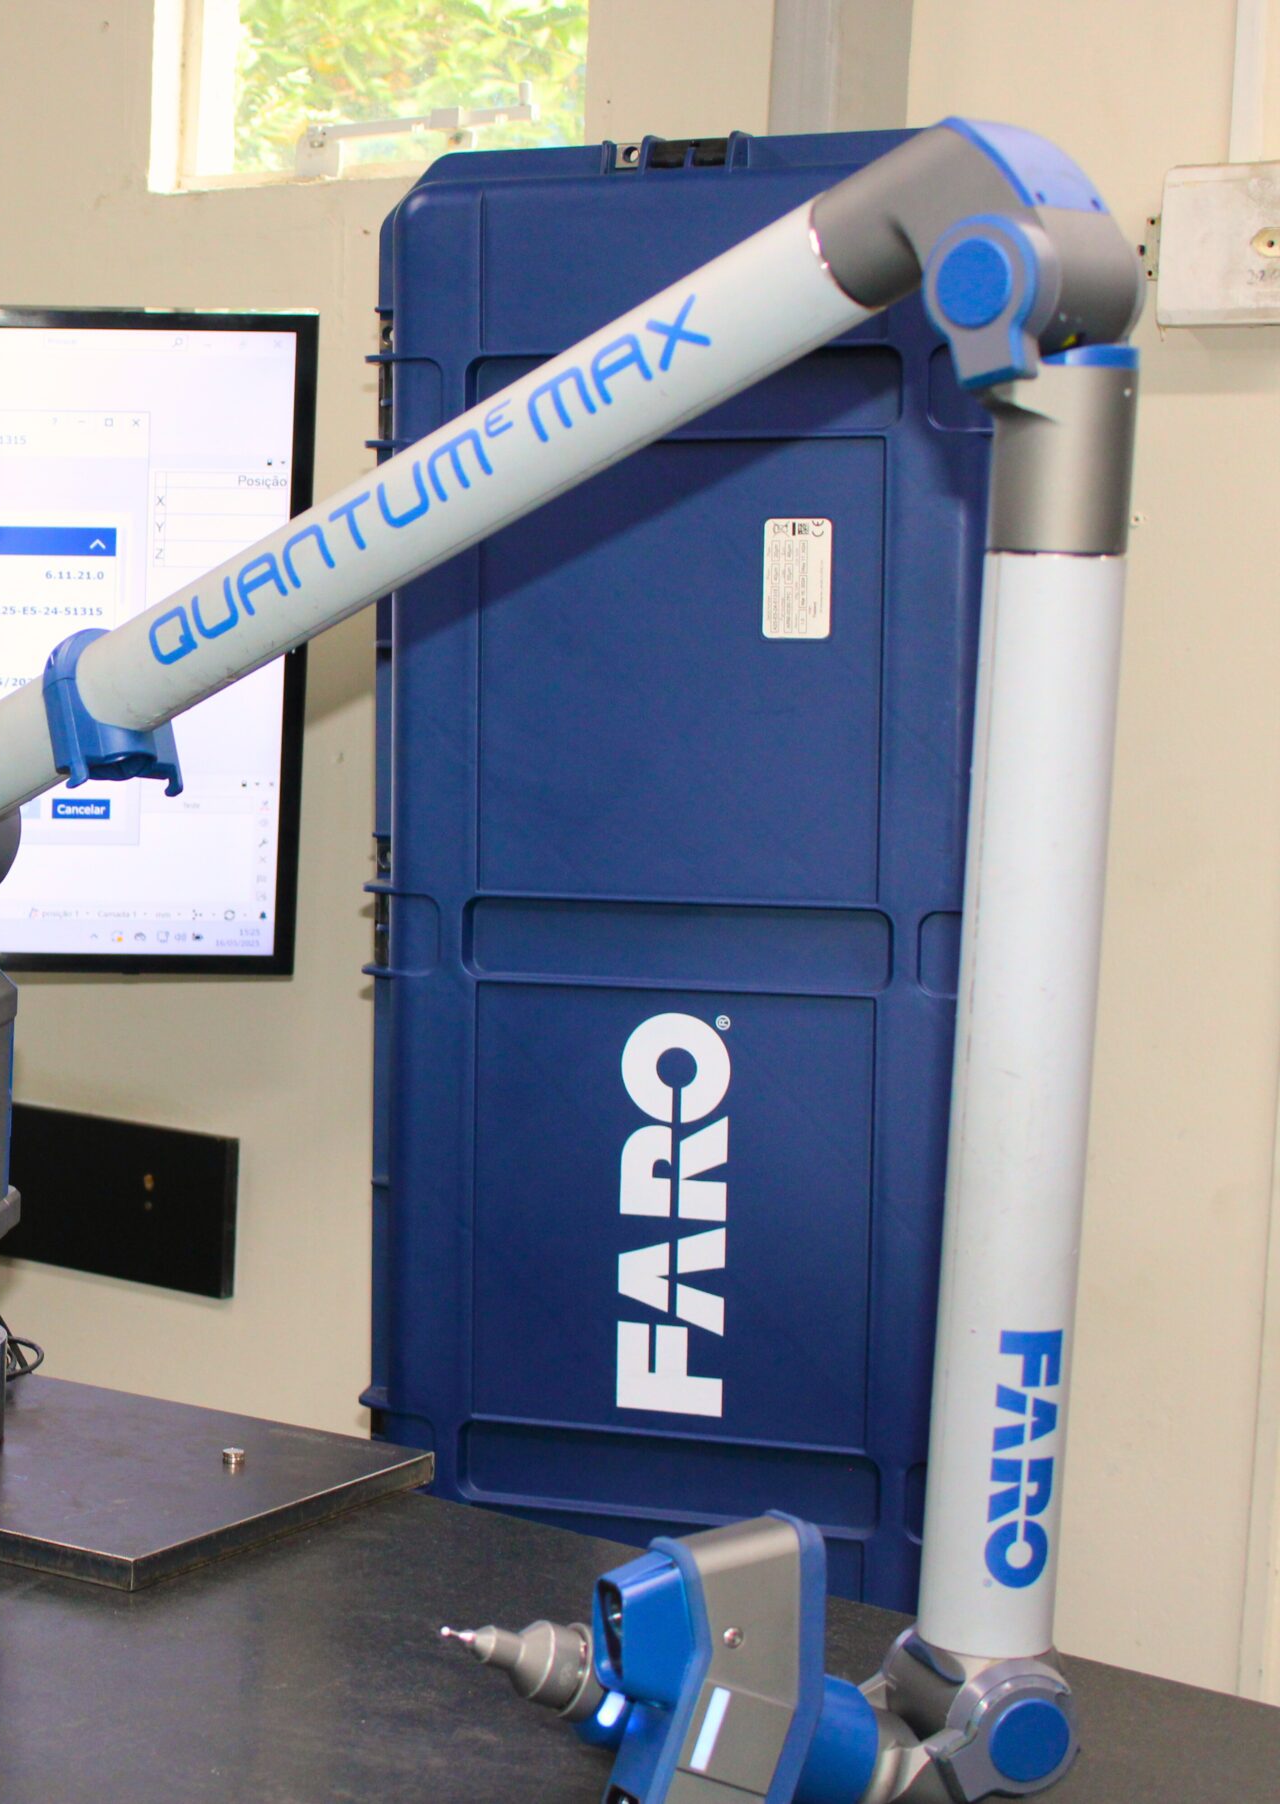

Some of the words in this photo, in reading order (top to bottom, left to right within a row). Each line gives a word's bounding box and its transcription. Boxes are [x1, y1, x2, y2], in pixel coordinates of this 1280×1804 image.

[148, 426, 494, 665] QUANTUM
[526, 293, 712, 443] MAX
[237, 474, 288, 488] Posição
[156, 496, 165, 507] X
[45, 570, 105, 582] 6.11.21.0
[56, 802, 105, 816] Cancelar
[984, 1329, 1064, 1589] FARO
